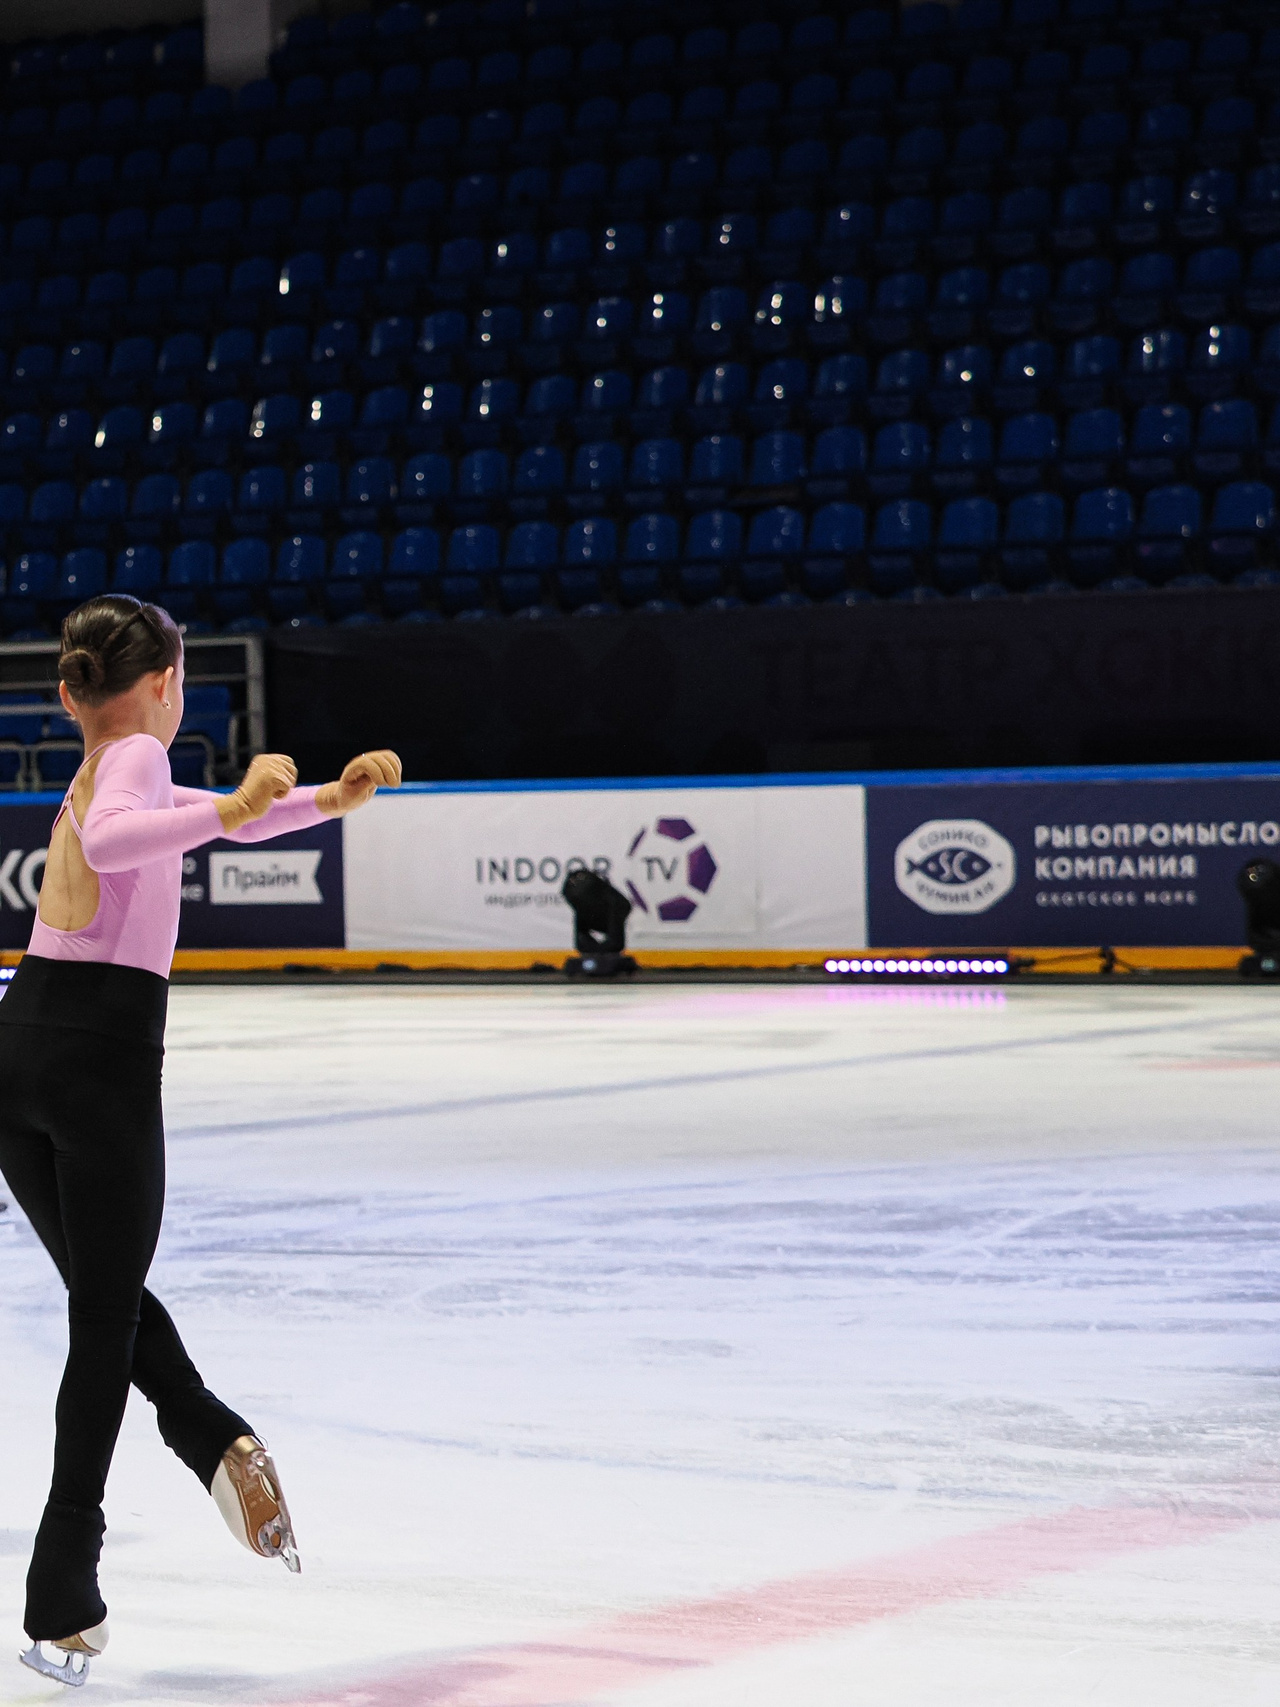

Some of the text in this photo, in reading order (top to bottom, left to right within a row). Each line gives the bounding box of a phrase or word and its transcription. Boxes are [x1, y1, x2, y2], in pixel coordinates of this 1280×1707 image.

[748, 636, 1011, 706] ТЕАТР
[1034, 821, 1280, 849] РЫБОПРОМЫСЛО
[642, 857, 679, 881] TV
[1034, 855, 1197, 880] КОМПАНИЯ
